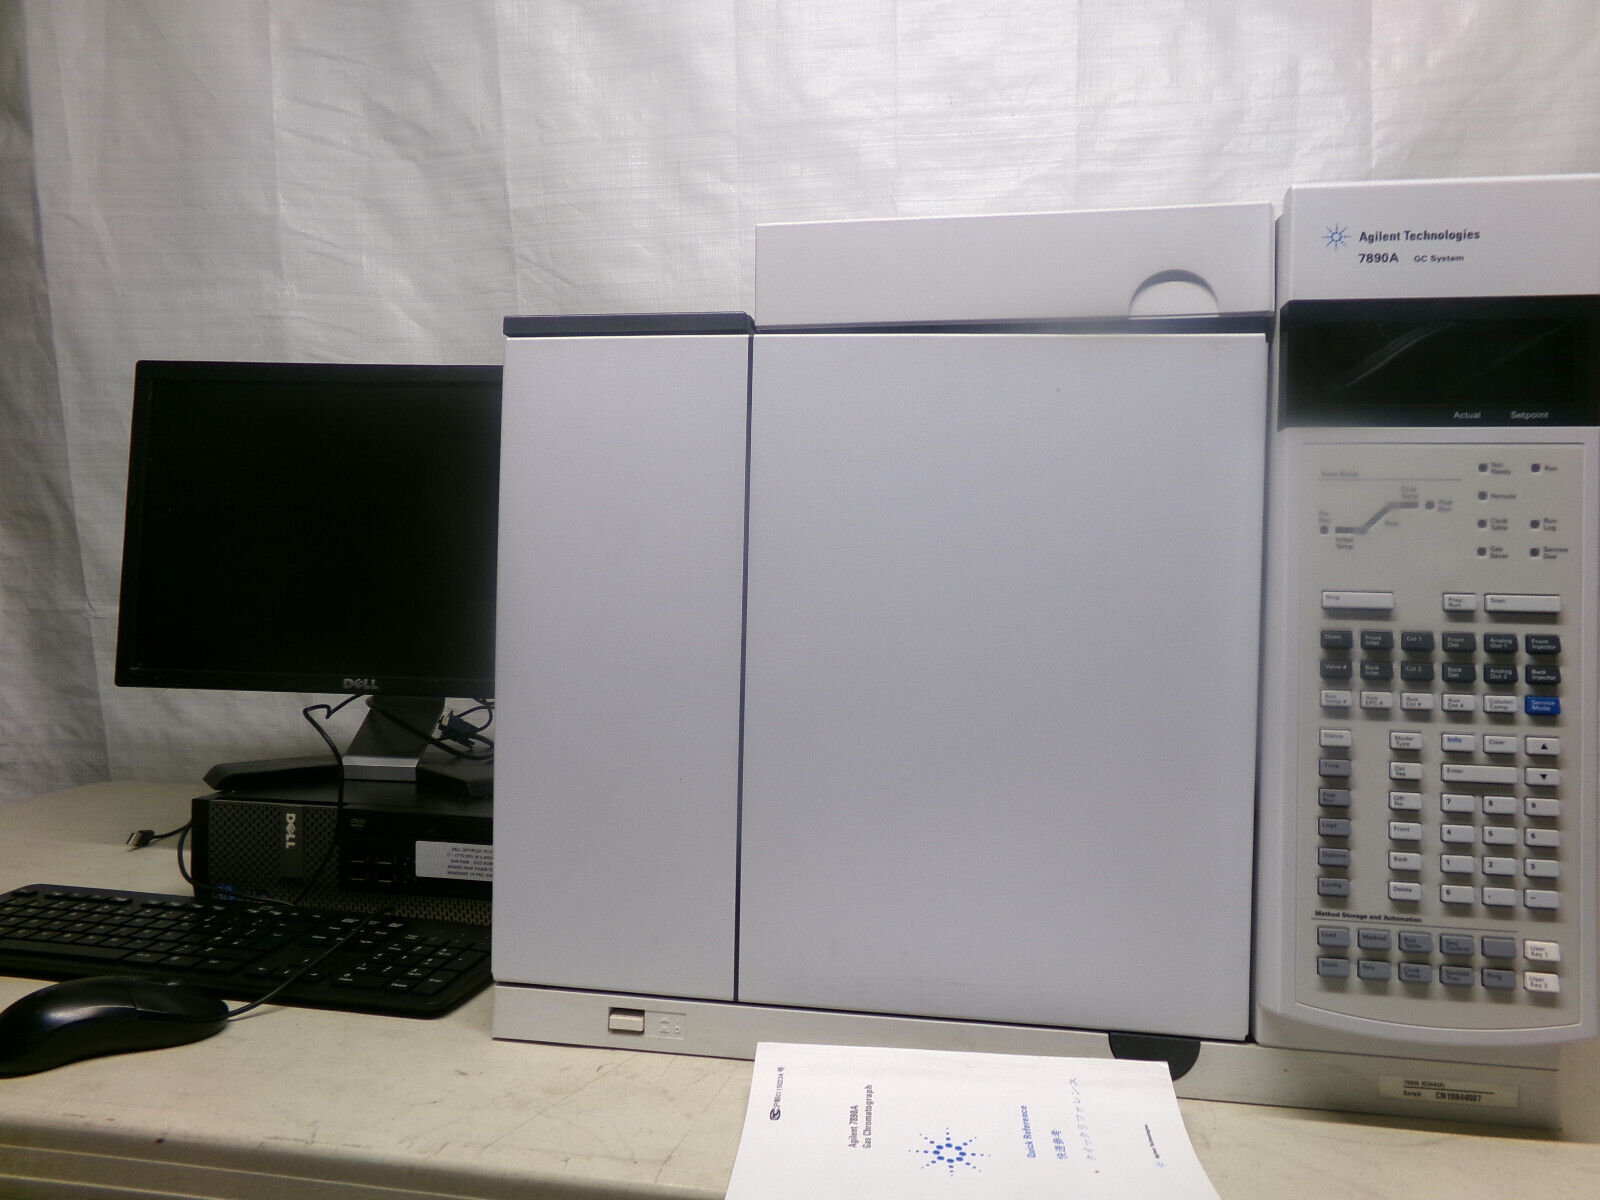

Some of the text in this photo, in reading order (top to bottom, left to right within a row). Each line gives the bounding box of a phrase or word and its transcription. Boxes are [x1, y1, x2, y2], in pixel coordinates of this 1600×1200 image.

[1359, 229, 1480, 244] Agilent Technologies
[1358, 253, 1399, 263] 7890A
[1431, 255, 1464, 264] System
[1453, 411, 1481, 419] Actual
[1511, 411, 1549, 420] Setpoint
[343, 679, 378, 690] DELL
[286, 813, 296, 848] DELL
[1315, 910, 1340, 918] Method
[1342, 912, 1367, 920] Storage
[862, 1084, 875, 1149] Gas Chromatograph
[848, 1105, 859, 1148] Agilent 7890A
[1021, 1105, 1036, 1158] Quick Reference
